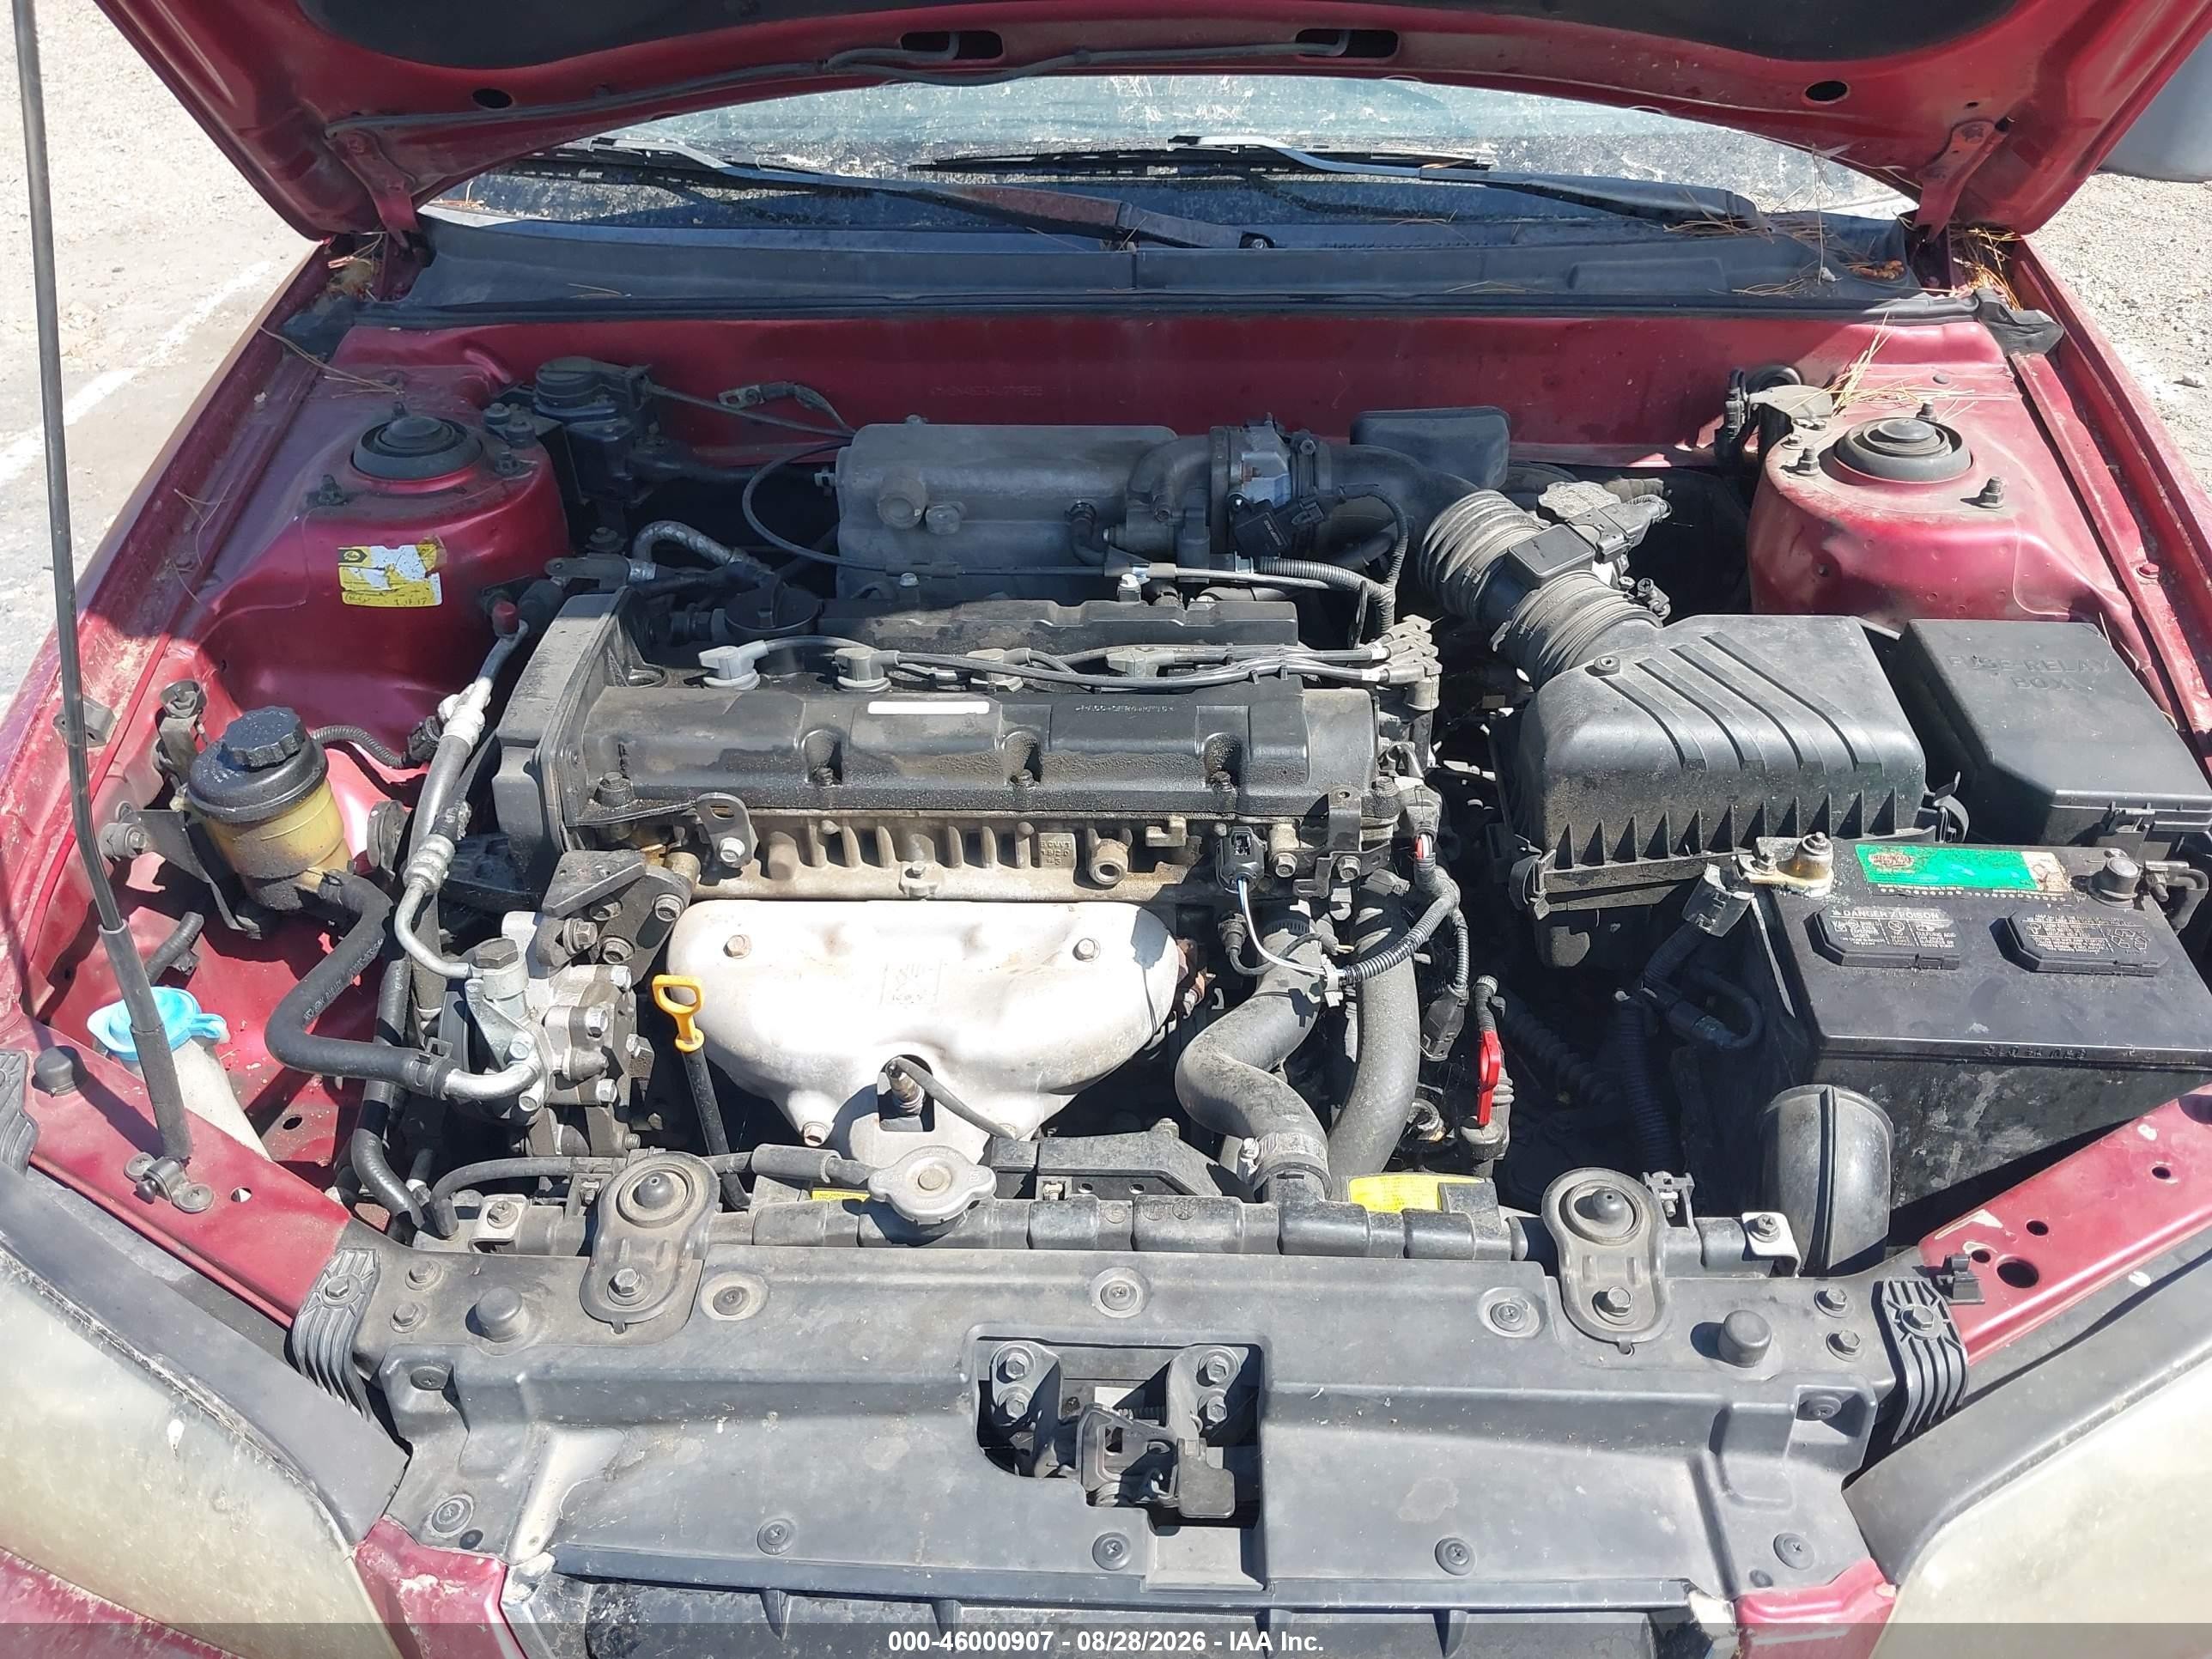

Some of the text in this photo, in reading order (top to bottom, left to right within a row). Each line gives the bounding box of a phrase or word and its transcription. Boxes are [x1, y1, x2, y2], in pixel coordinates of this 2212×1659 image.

[2009, 675, 2073, 690] BOX
[1843, 909, 1887, 918] DANGER
[1899, 911, 1939, 920] POISON
